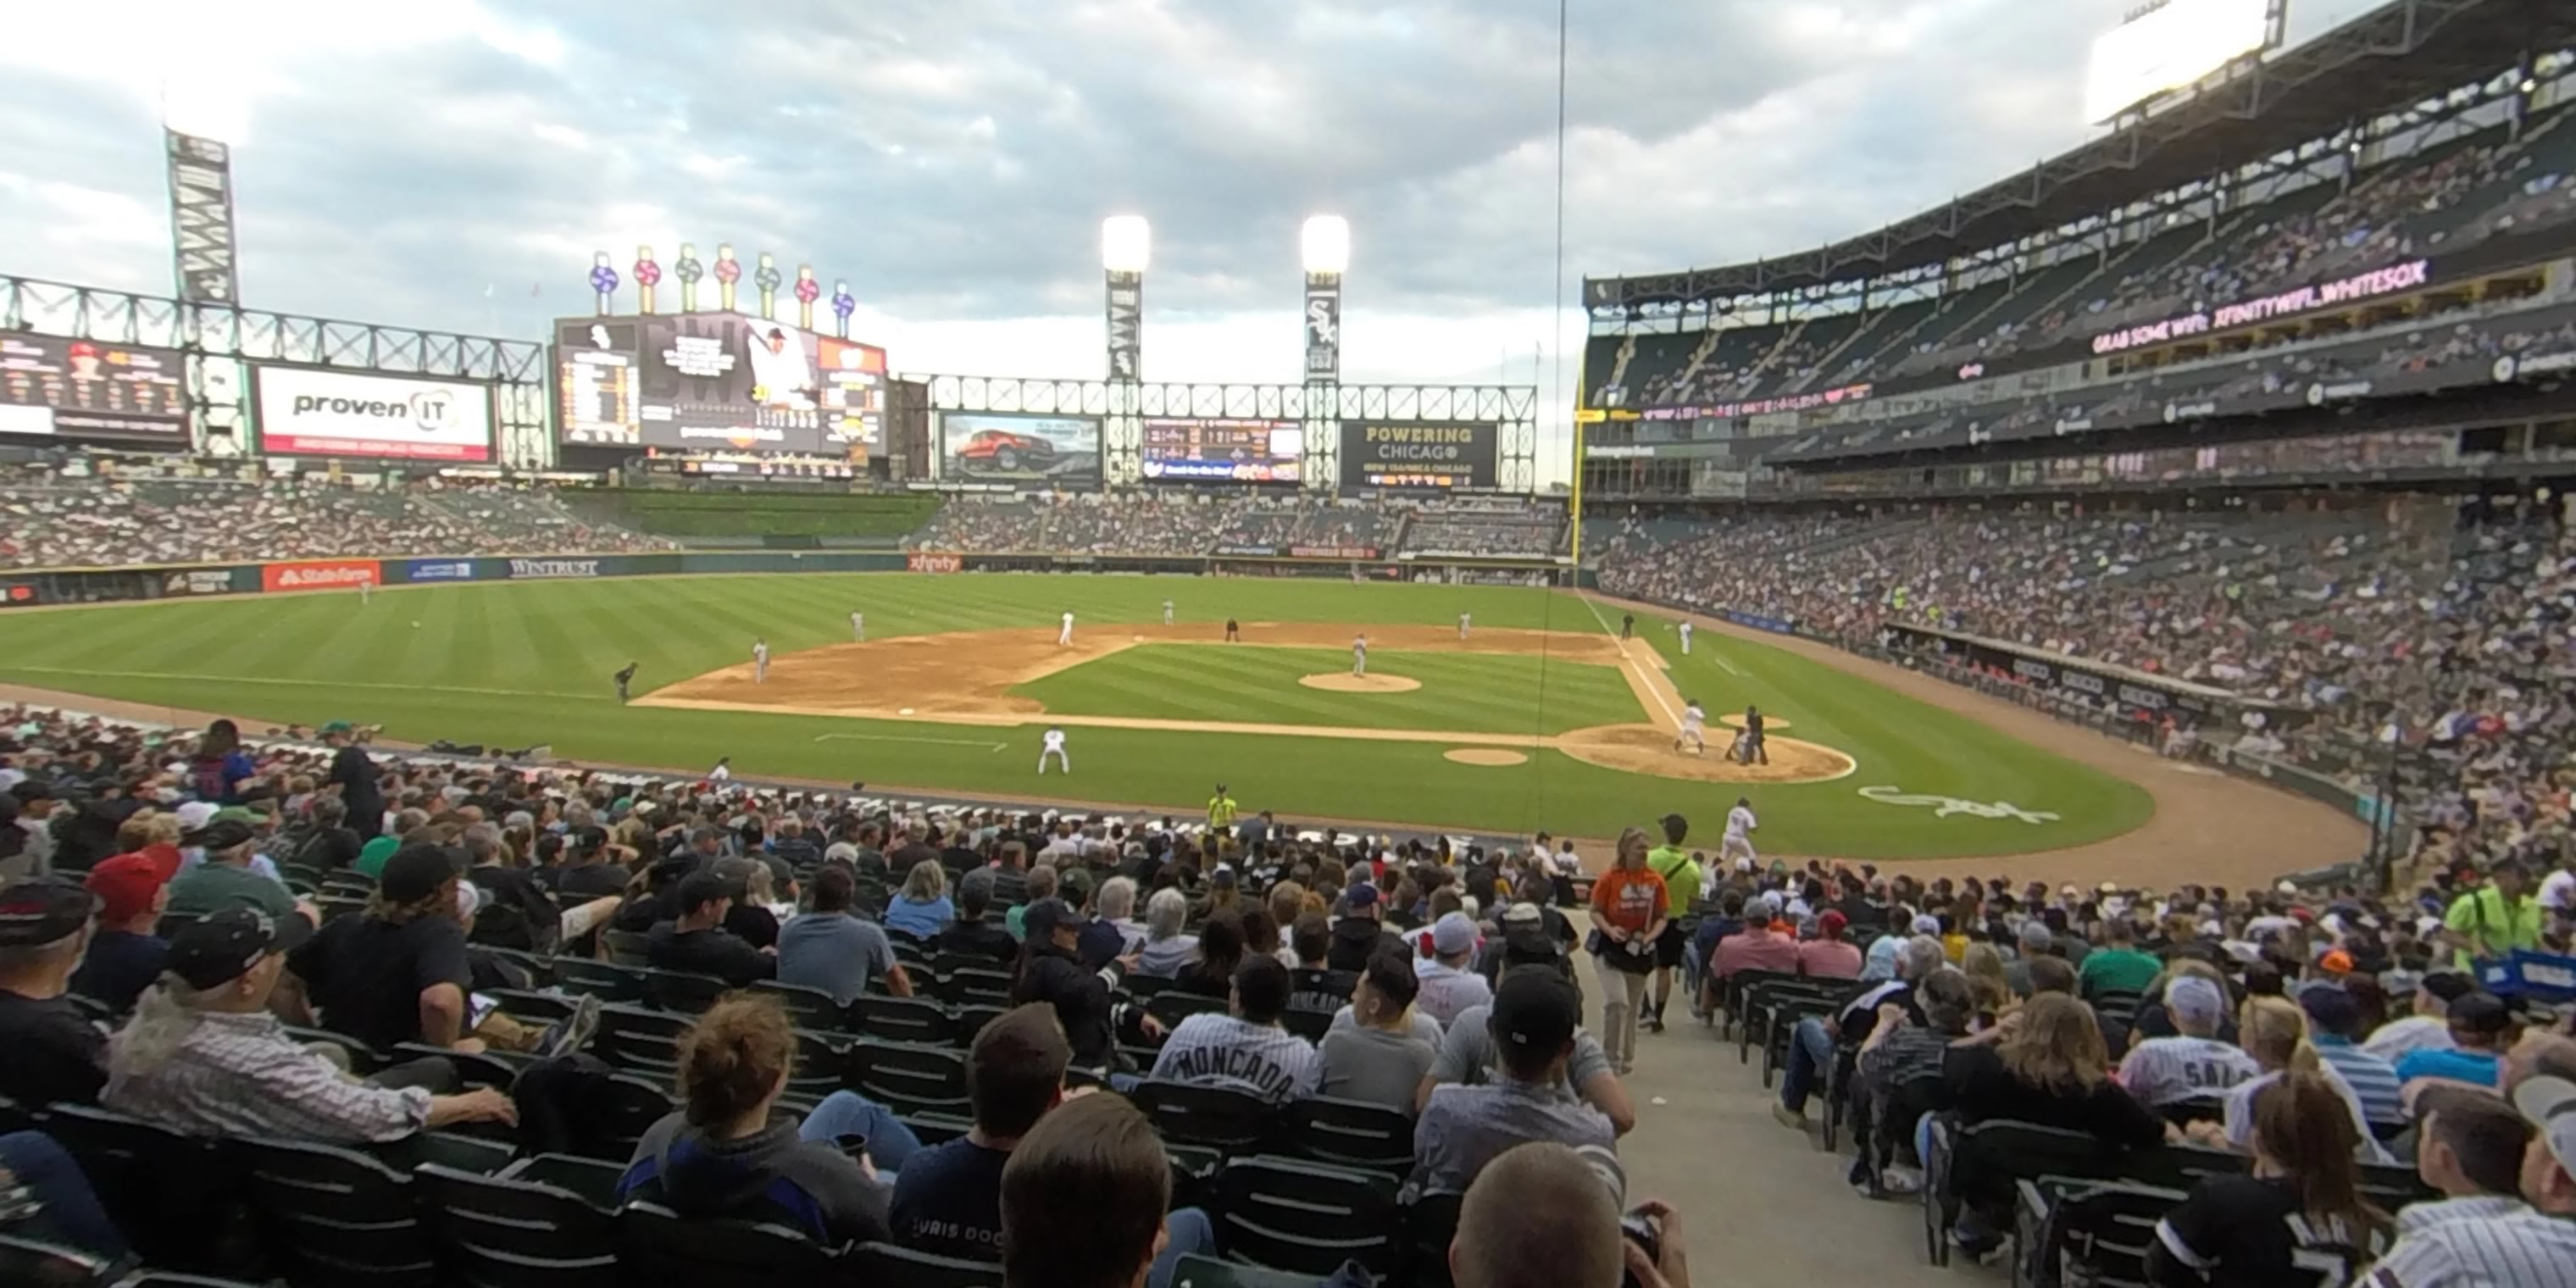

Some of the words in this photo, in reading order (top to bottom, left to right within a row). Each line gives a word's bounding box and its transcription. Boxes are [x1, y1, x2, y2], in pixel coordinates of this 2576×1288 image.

[2130, 320, 2169, 347] SOME
[292, 395, 408, 417] proven
[423, 401, 446, 420] IT
[1365, 426, 1473, 443] POWERING
[509, 558, 598, 579] WINTRUST
[909, 553, 961, 573] xfinity
[1175, 1046, 1295, 1102] MONCADA
